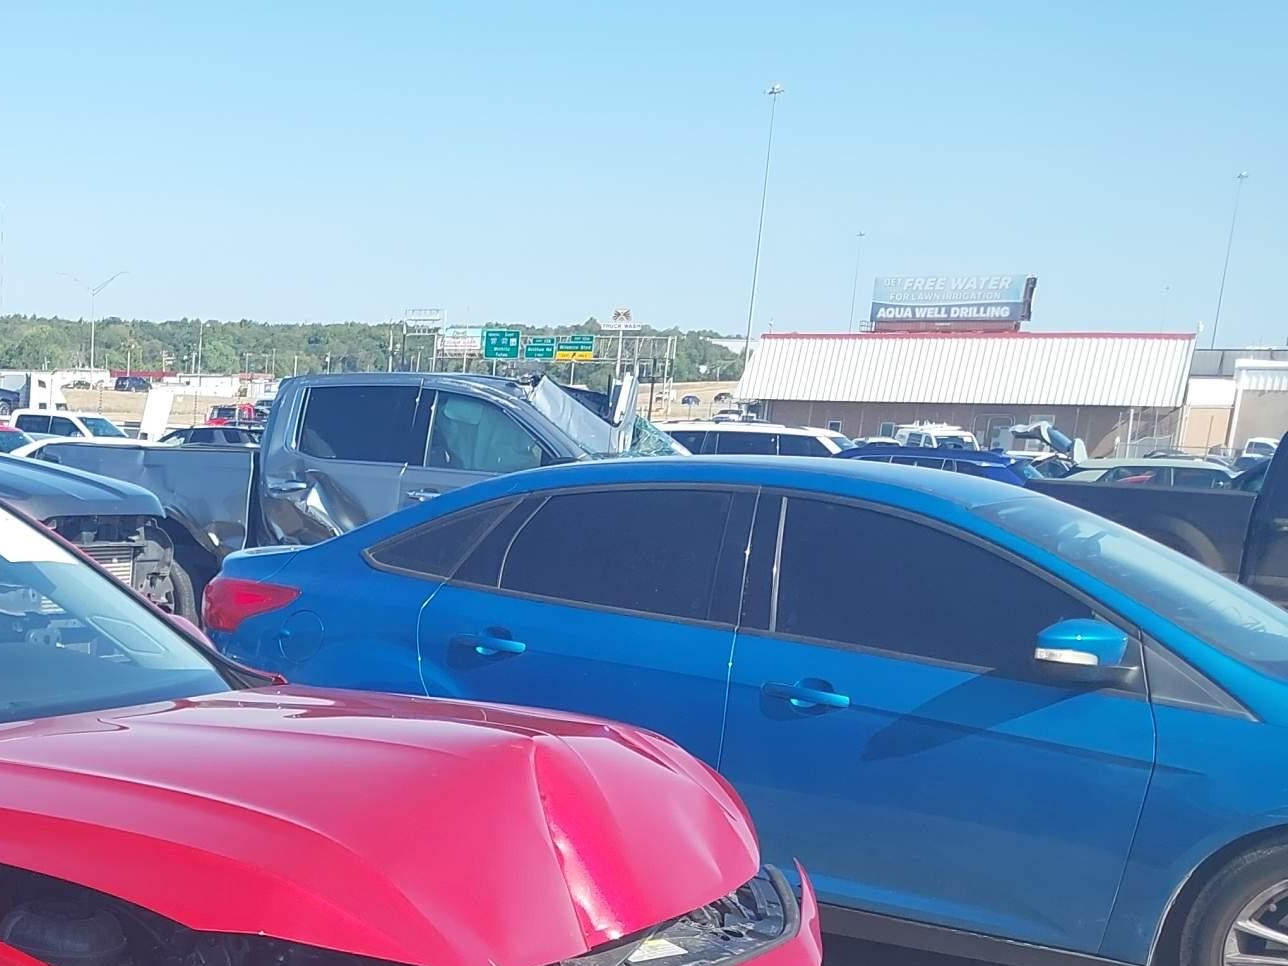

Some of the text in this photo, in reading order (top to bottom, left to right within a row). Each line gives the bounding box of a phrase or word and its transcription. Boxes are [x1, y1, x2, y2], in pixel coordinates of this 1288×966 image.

[903, 278, 945, 290] FREE
[951, 276, 1012, 290] WATER
[890, 292, 1001, 302] FOR LAWN IRRIGATION
[877, 307, 1010, 318] AQUA WELL DRILLING
